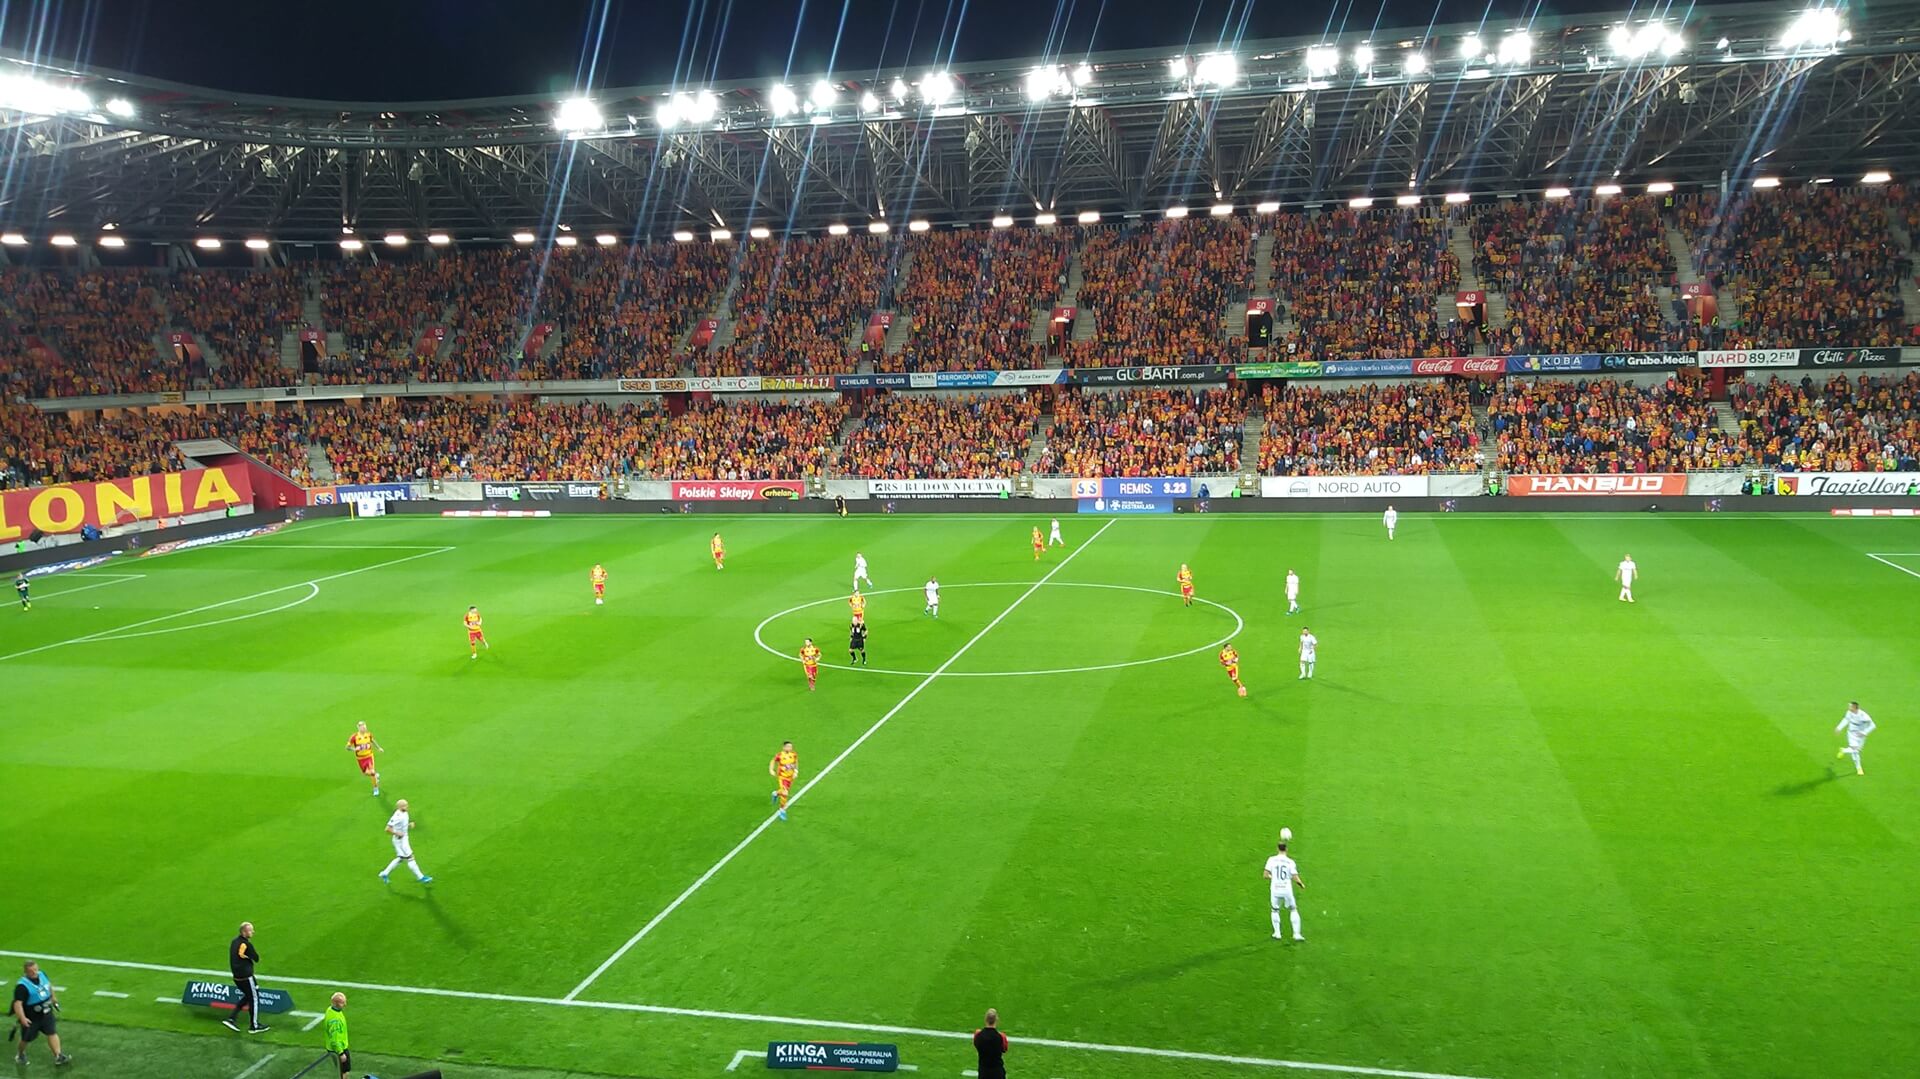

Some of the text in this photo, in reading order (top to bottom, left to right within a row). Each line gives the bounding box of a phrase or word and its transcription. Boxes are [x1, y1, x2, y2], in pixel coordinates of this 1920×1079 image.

[1688, 285, 1699, 293] 48
[1465, 293, 1476, 301] 49
[1256, 302, 1266, 310] 50
[880, 316, 889, 324] 52
[1543, 357, 1581, 365] KOBA
[1627, 355, 1695, 366] Grube.Media
[1706, 354, 1747, 364] JARD
[1780, 352, 1794, 360] FM
[1859, 350, 1886, 362] Pizza
[1116, 367, 1181, 381] GLOBART
[905, 483, 1005, 492] BUDOWNICTWO
[1120, 482, 1187, 494] REMIS: 3.23
[1318, 482, 1360, 493] NORD
[1364, 482, 1401, 493] AUTO
[1530, 477, 1663, 491] HANBUD
[568, 484, 600, 497] Energ
[679, 487, 754, 500] Polskie Sklepy
[1276, 865, 1287, 880] 16
[191, 983, 230, 997] KINGA
[776, 1044, 827, 1058] KINGA
[833, 1048, 892, 1058] GÓRSKA MINERALNA
